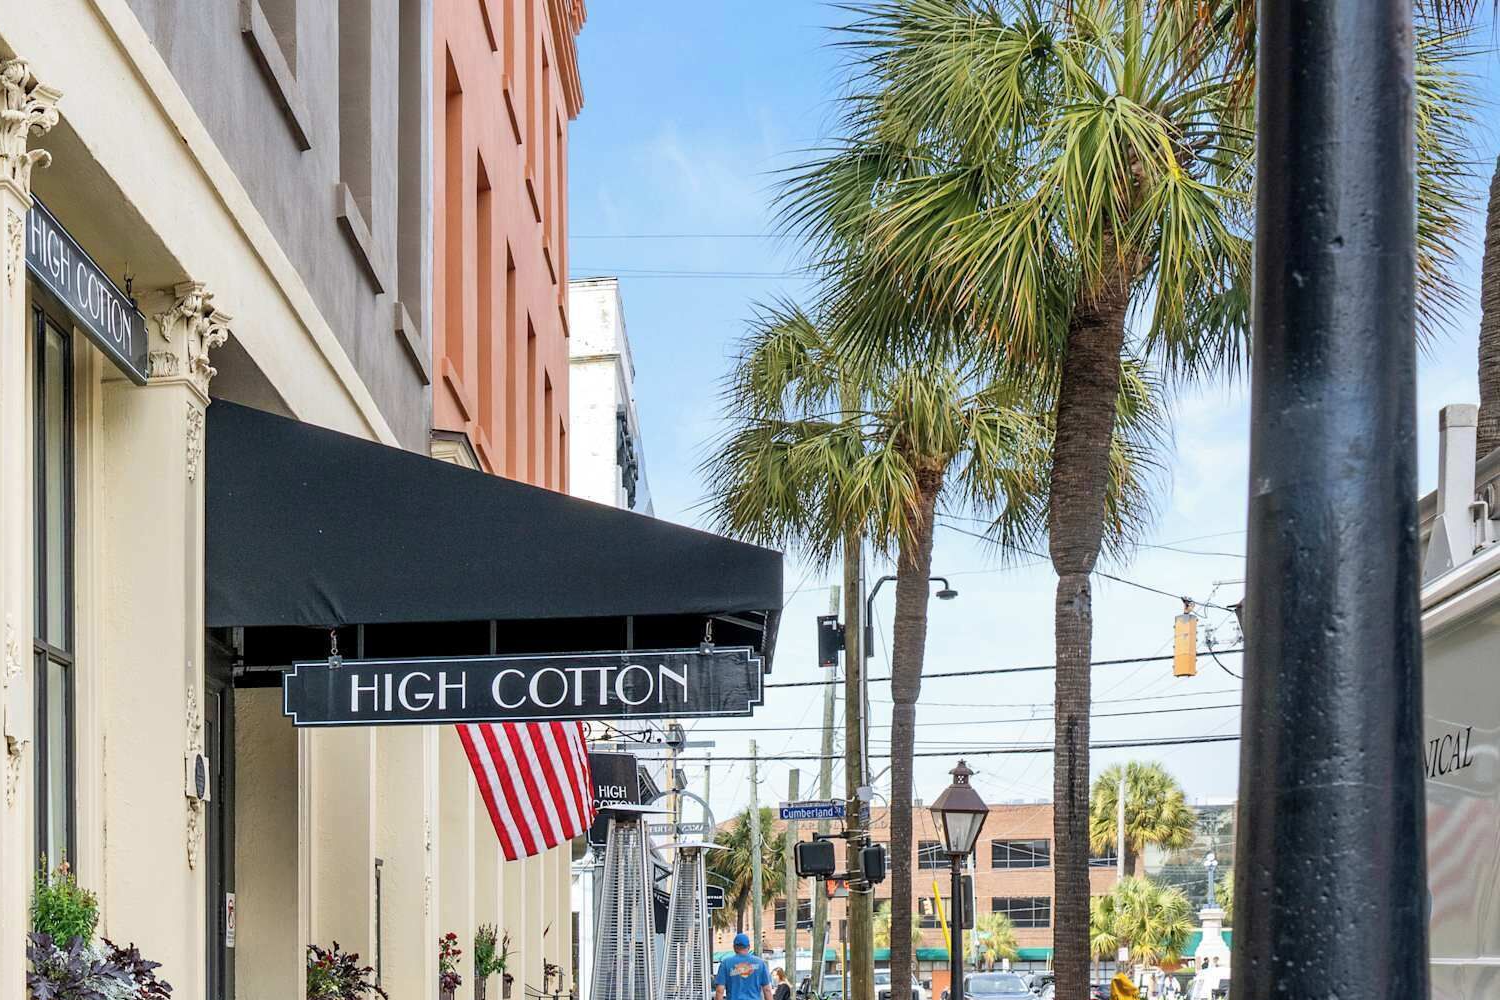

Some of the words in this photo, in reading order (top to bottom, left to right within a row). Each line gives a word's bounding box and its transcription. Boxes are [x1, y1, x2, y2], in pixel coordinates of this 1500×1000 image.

[30, 207, 71, 291] HIGH
[76, 262, 133, 357] COTTON
[350, 671, 467, 712] HIGH
[491, 664, 688, 709] COTTON
[598, 785, 627, 799] HIGH
[782, 808, 833, 819] Cumberland
